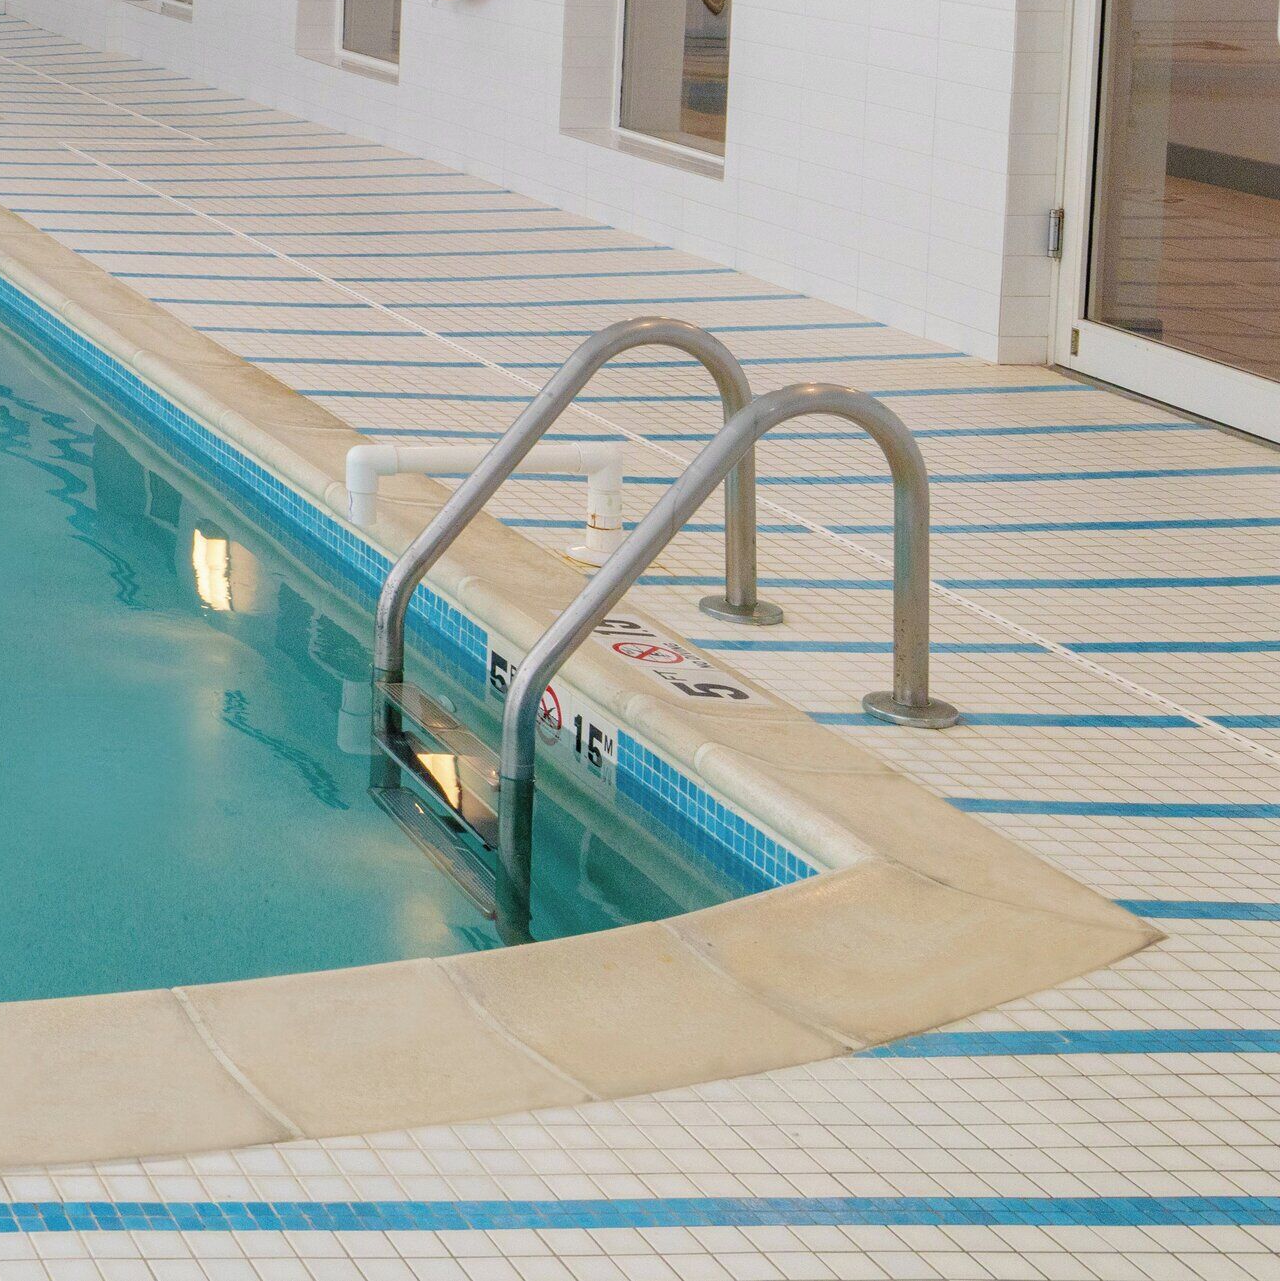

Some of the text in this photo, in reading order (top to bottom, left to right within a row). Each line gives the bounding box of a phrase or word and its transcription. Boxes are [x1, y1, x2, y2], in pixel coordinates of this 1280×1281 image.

[490, 650, 508, 694] 5
[604, 734, 613, 756] M
[671, 681, 750, 700] 5
